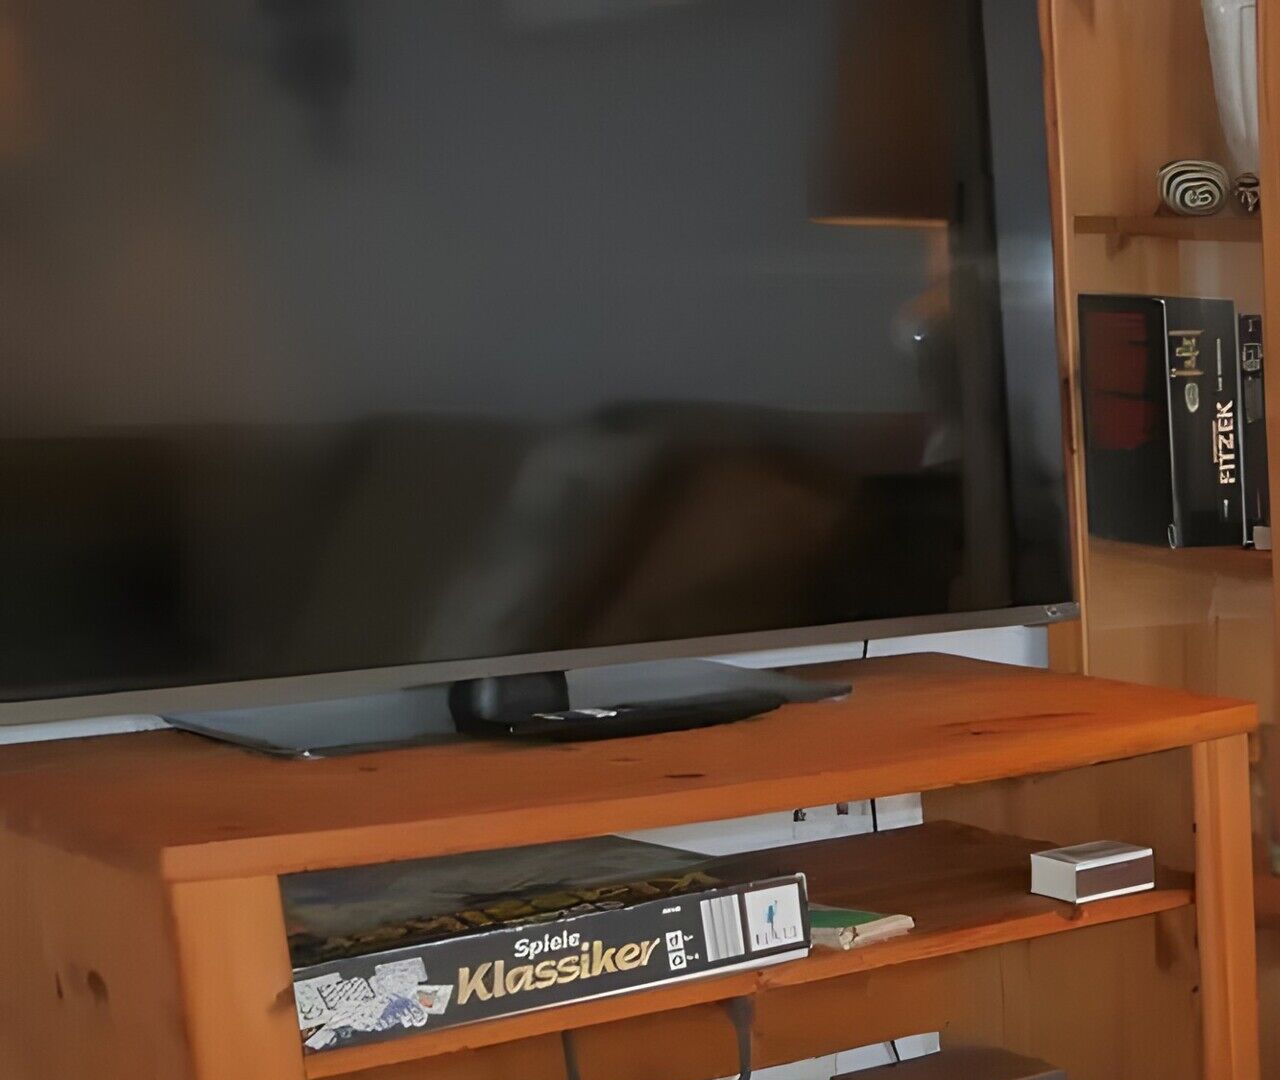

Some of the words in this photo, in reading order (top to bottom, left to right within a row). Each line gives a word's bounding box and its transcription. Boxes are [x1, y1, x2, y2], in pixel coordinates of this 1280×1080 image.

[1213, 400, 1236, 484] FITZEK
[457, 937, 661, 1006] Klassiker
[514, 930, 581, 960] Spiele
